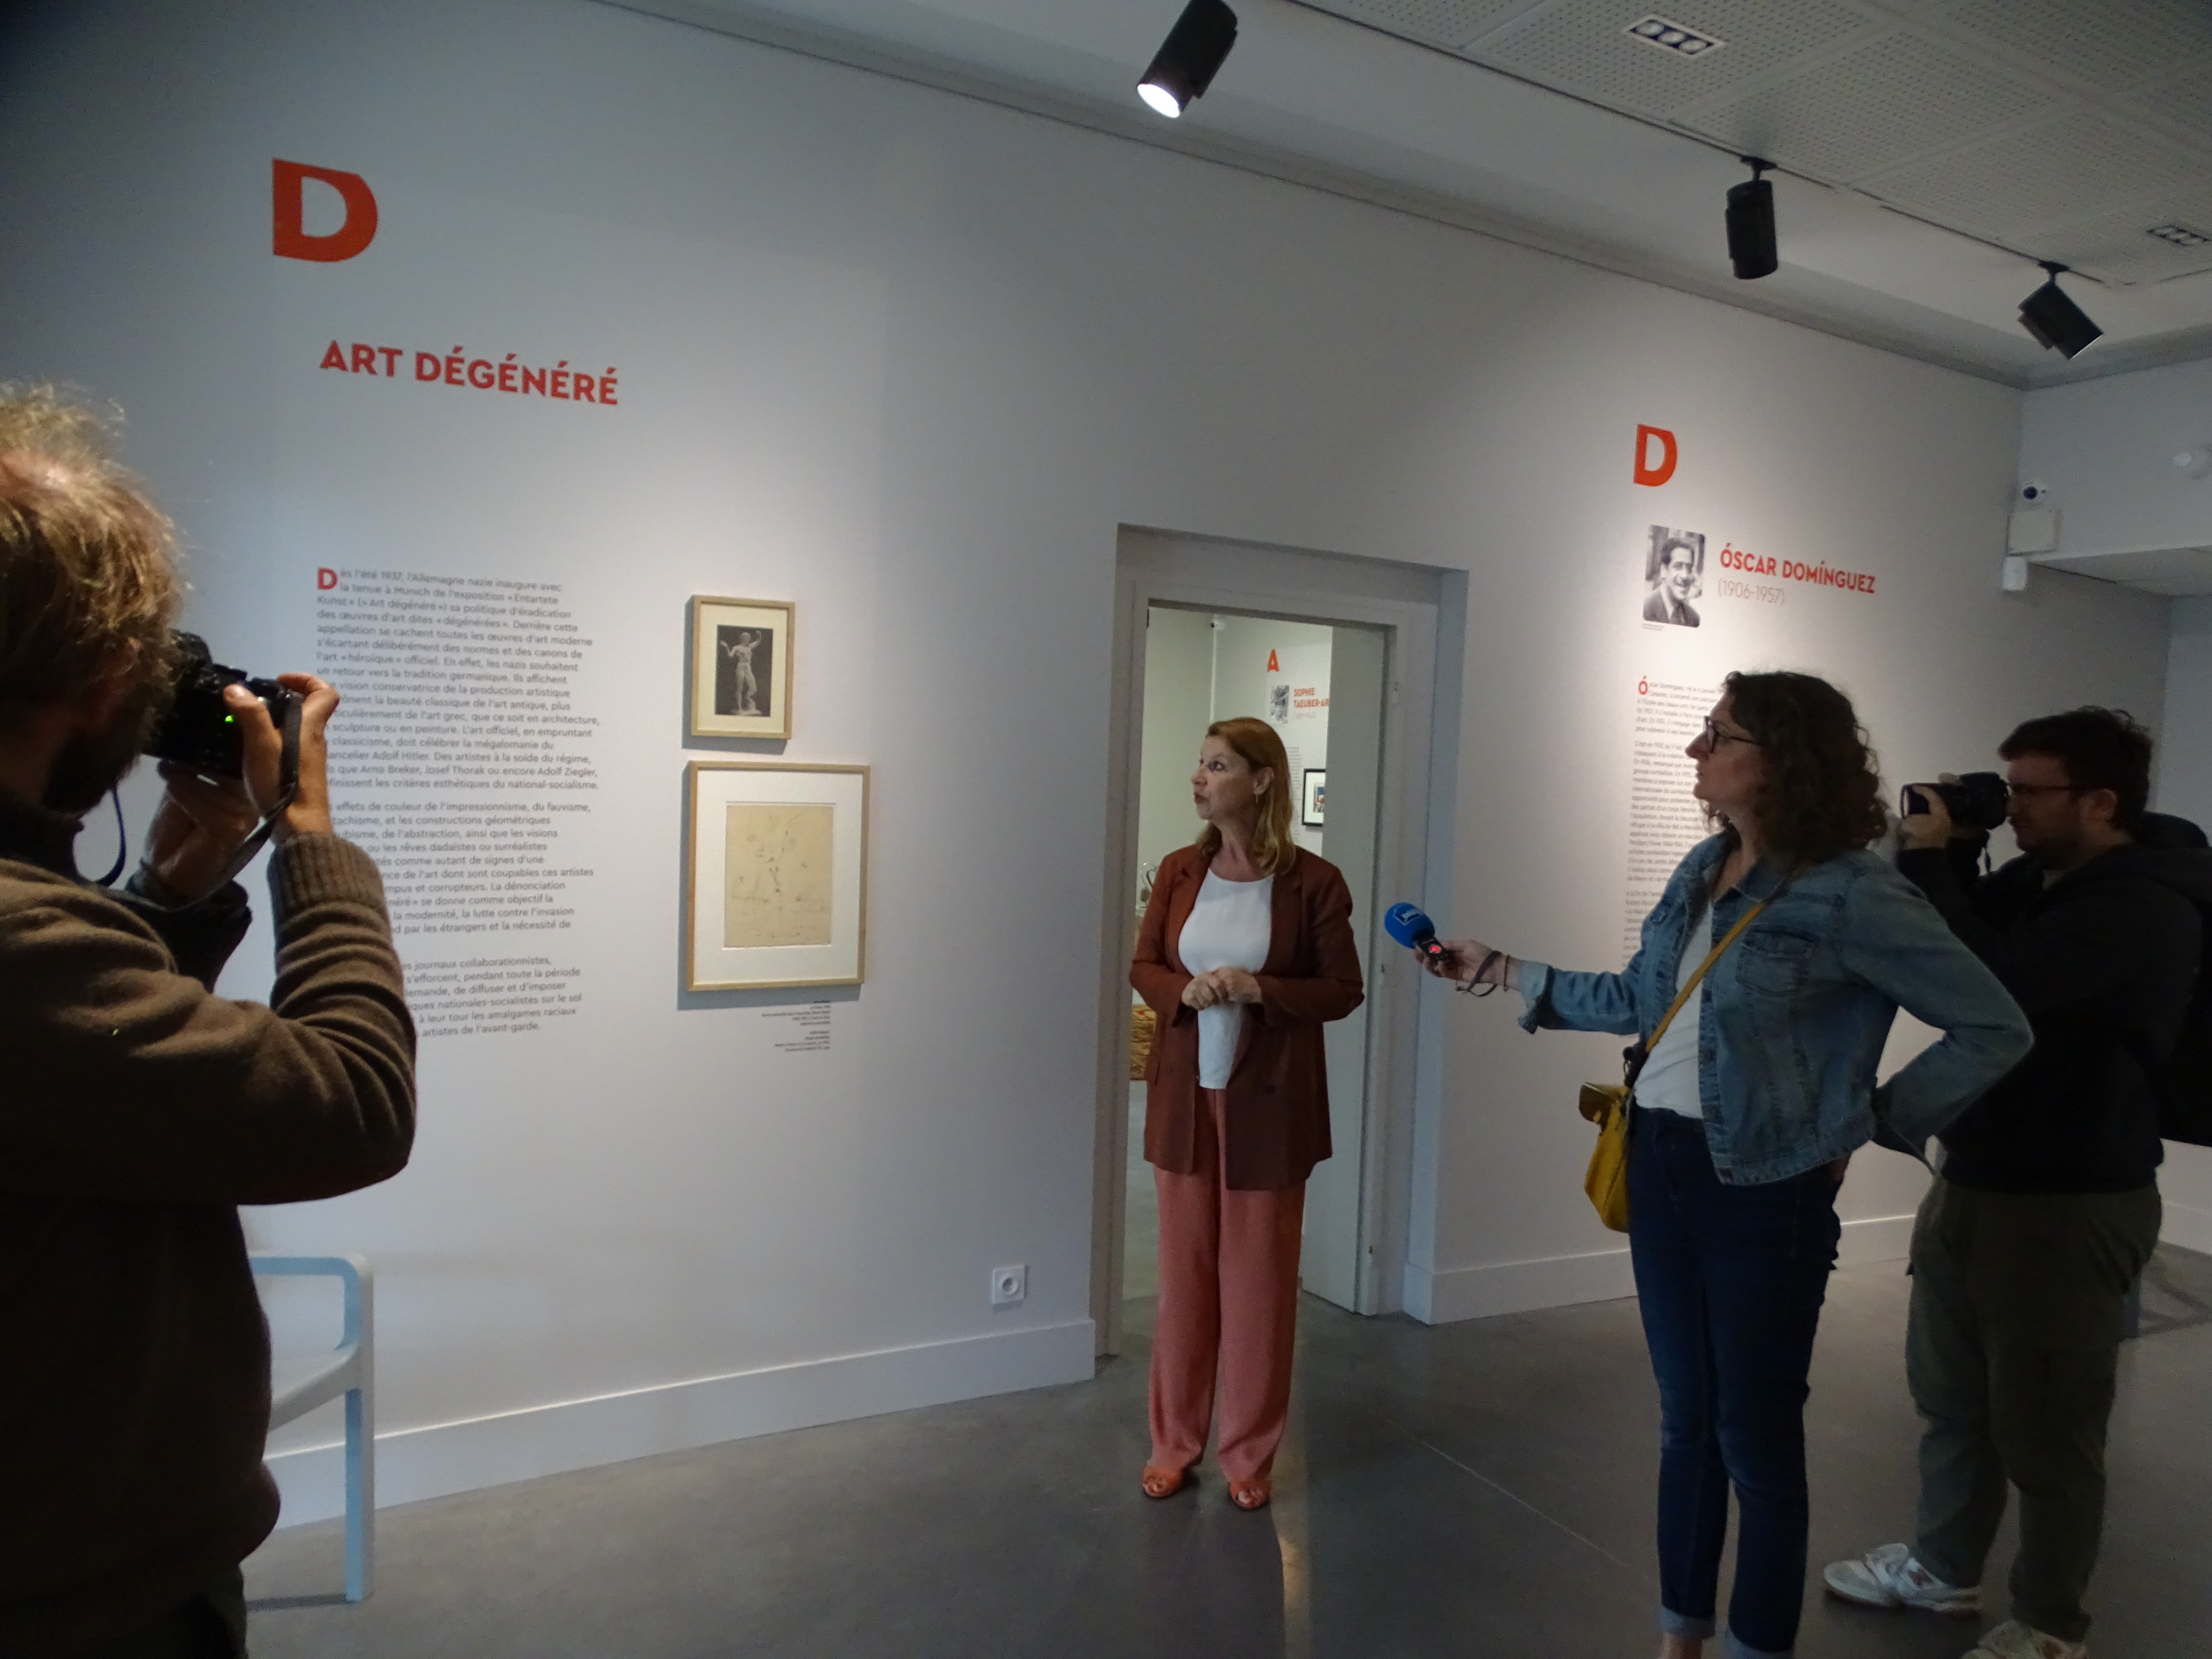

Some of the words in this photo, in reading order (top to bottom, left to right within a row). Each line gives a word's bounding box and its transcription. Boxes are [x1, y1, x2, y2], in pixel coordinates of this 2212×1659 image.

[272, 158, 378, 263] D
[320, 340, 403, 378] ART
[415, 346, 618, 406] DÉGÉNÉRÉ
[1633, 423, 1678, 487] D
[1720, 542, 1777, 577] ÓSCAR
[1781, 560, 1876, 594] DOMÍNGUEZ
[467, 578, 493, 587] nazie
[495, 579, 538, 591] inaugure
[540, 583, 562, 591] avec
[1718, 577, 1784, 606] (1906-1957)
[463, 603, 506, 616] politique
[512, 619, 551, 630] Derrière
[553, 623, 578, 632] cette
[470, 630, 484, 640] les
[487, 633, 523, 642] œuvres
[550, 635, 593, 646] moderne
[463, 646, 499, 654] normes
[502, 646, 512, 655] et
[515, 646, 532, 656] des
[534, 649, 568, 658] canons
[570, 649, 582, 658] de
[486, 658, 500, 668] les
[502, 661, 527, 669] nazis
[529, 661, 578, 671] souhaitent
[1267, 649, 1280, 672] A
[513, 672, 524, 682] Ils
[526, 673, 567, 684] affichent
[469, 685, 524, 696] production
[526, 688, 570, 699] artistique
[1294, 687, 1315, 697] SOPHIE
[551, 701, 570, 712] plus
[471, 713, 490, 722] que
[506, 713, 524, 722] soit
[537, 728, 592, 738] empruntant
[474, 738, 539, 750] mégalomanie
[541, 740, 553, 749] du
[455, 752, 491, 761] artistes
[494, 752, 500, 761] à
[502, 752, 511, 761] la
[513, 752, 539, 762] solde
[541, 753, 553, 762] du
[452, 765, 485, 774] Thorak
[537, 766, 562, 776] Adolf
[492, 779, 505, 788] du
[532, 801, 544, 811] du
[415, 816, 483, 824] constructions
[484, 815, 550, 826] géométriques
[465, 829, 487, 838] ainsi
[489, 830, 508, 839] que
[510, 828, 524, 837] les
[527, 829, 558, 837] visions
[494, 841, 547, 851] surréalistes
[434, 856, 466, 864] autant
[469, 855, 482, 864] de
[484, 856, 515, 866] signes
[441, 869, 465, 878] dont
[467, 869, 489, 878] sont
[491, 867, 540, 879] coupables
[560, 867, 594, 876] artistes
[491, 881, 502, 891] La
[504, 881, 566, 890] dénonciation
[435, 896, 466, 905] donne
[507, 893, 544, 905] objectif
[472, 908, 495, 917] lutte
[497, 908, 529, 917] contre
[423, 923, 437, 933] les
[439, 923, 487, 933] étrangers
[512, 919, 556, 929] nécessité
[414, 960, 457, 972] journaux
[464, 970, 504, 982] pendant
[506, 970, 532, 979] toute
[545, 966, 581, 979] période
[469, 984, 504, 993] diffuser
[569, 992, 582, 1002] sol
[427, 1013, 446, 1023] leur
[448, 1013, 469, 1022] tour
[472, 1011, 485, 1020] les
[487, 1009, 541, 1020] amalgames
[544, 1007, 576, 1016] raciaux
[422, 1027, 458, 1036] artistes
